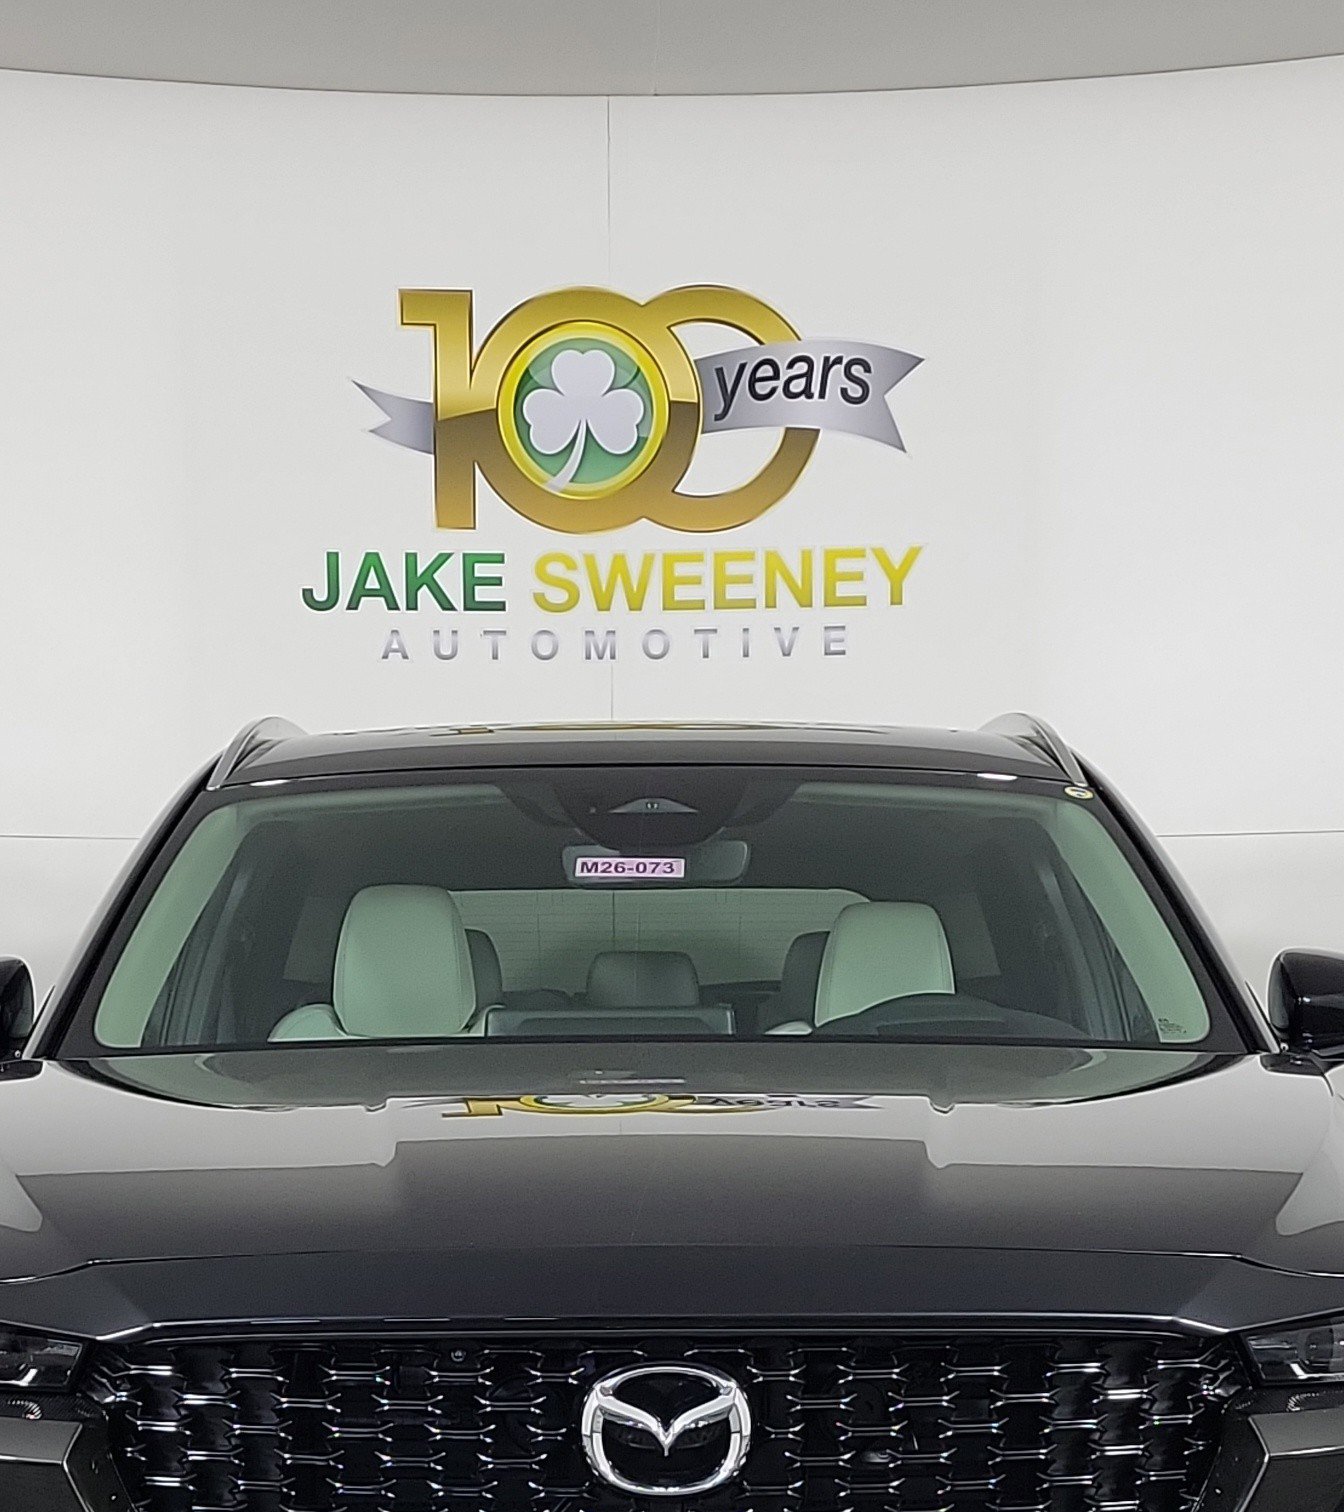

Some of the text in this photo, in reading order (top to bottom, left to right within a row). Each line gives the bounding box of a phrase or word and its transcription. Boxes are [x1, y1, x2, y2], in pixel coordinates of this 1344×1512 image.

[398, 285, 873, 533] 100 years
[302, 546, 922, 612] JAKE SWEENEY
[381, 625, 848, 661] AUTOMOTIVE
[580, 861, 675, 874] M26-073
